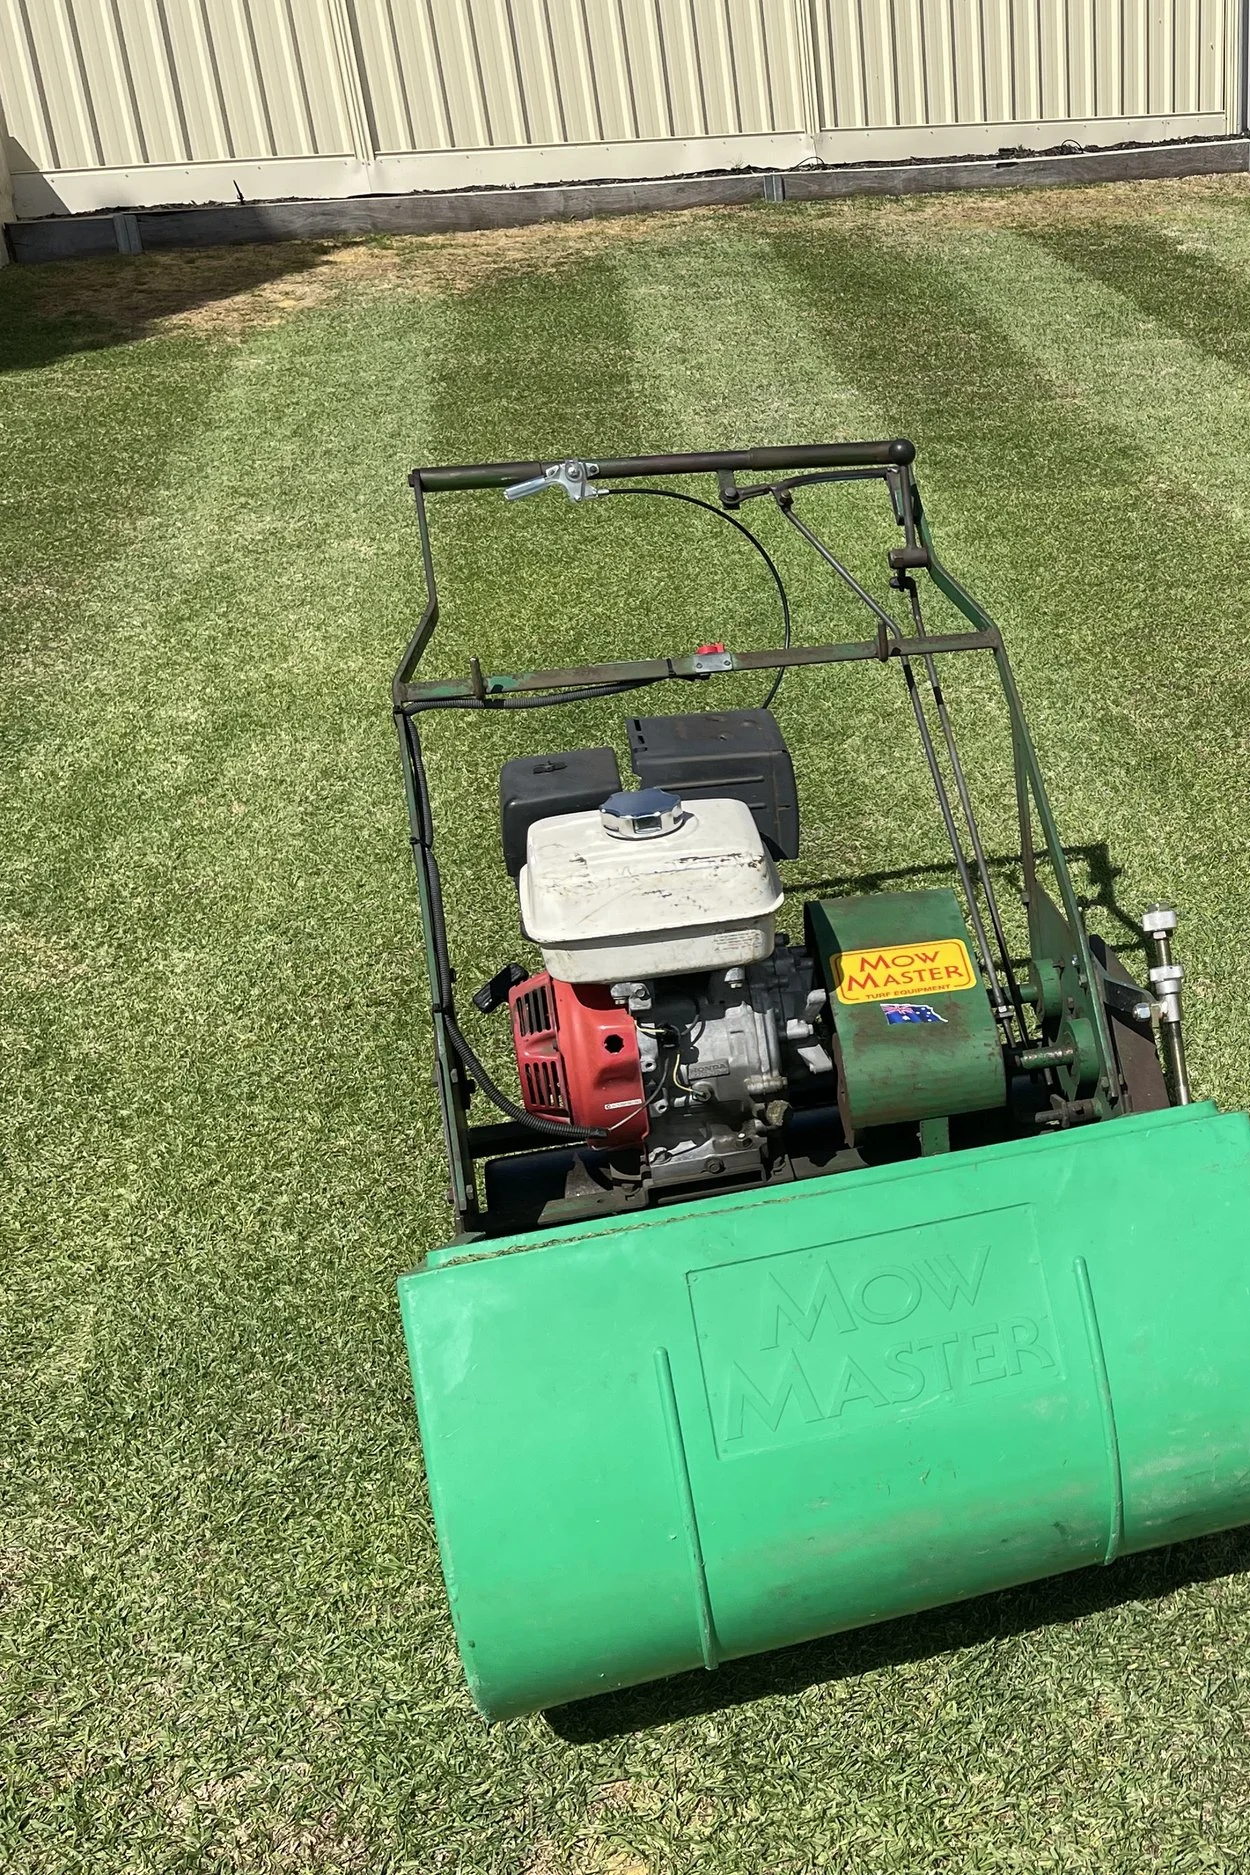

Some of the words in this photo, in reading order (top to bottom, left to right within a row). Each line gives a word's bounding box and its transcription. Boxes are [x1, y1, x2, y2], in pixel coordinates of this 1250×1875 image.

[859, 951, 940, 973] MOW
[847, 965, 964, 992] MASTER
[865, 991, 892, 1000] TURF
[893, 984, 951, 996] EQUIPMENT
[760, 1245, 992, 1351] MOW
[723, 1315, 1056, 1441] MASTER
